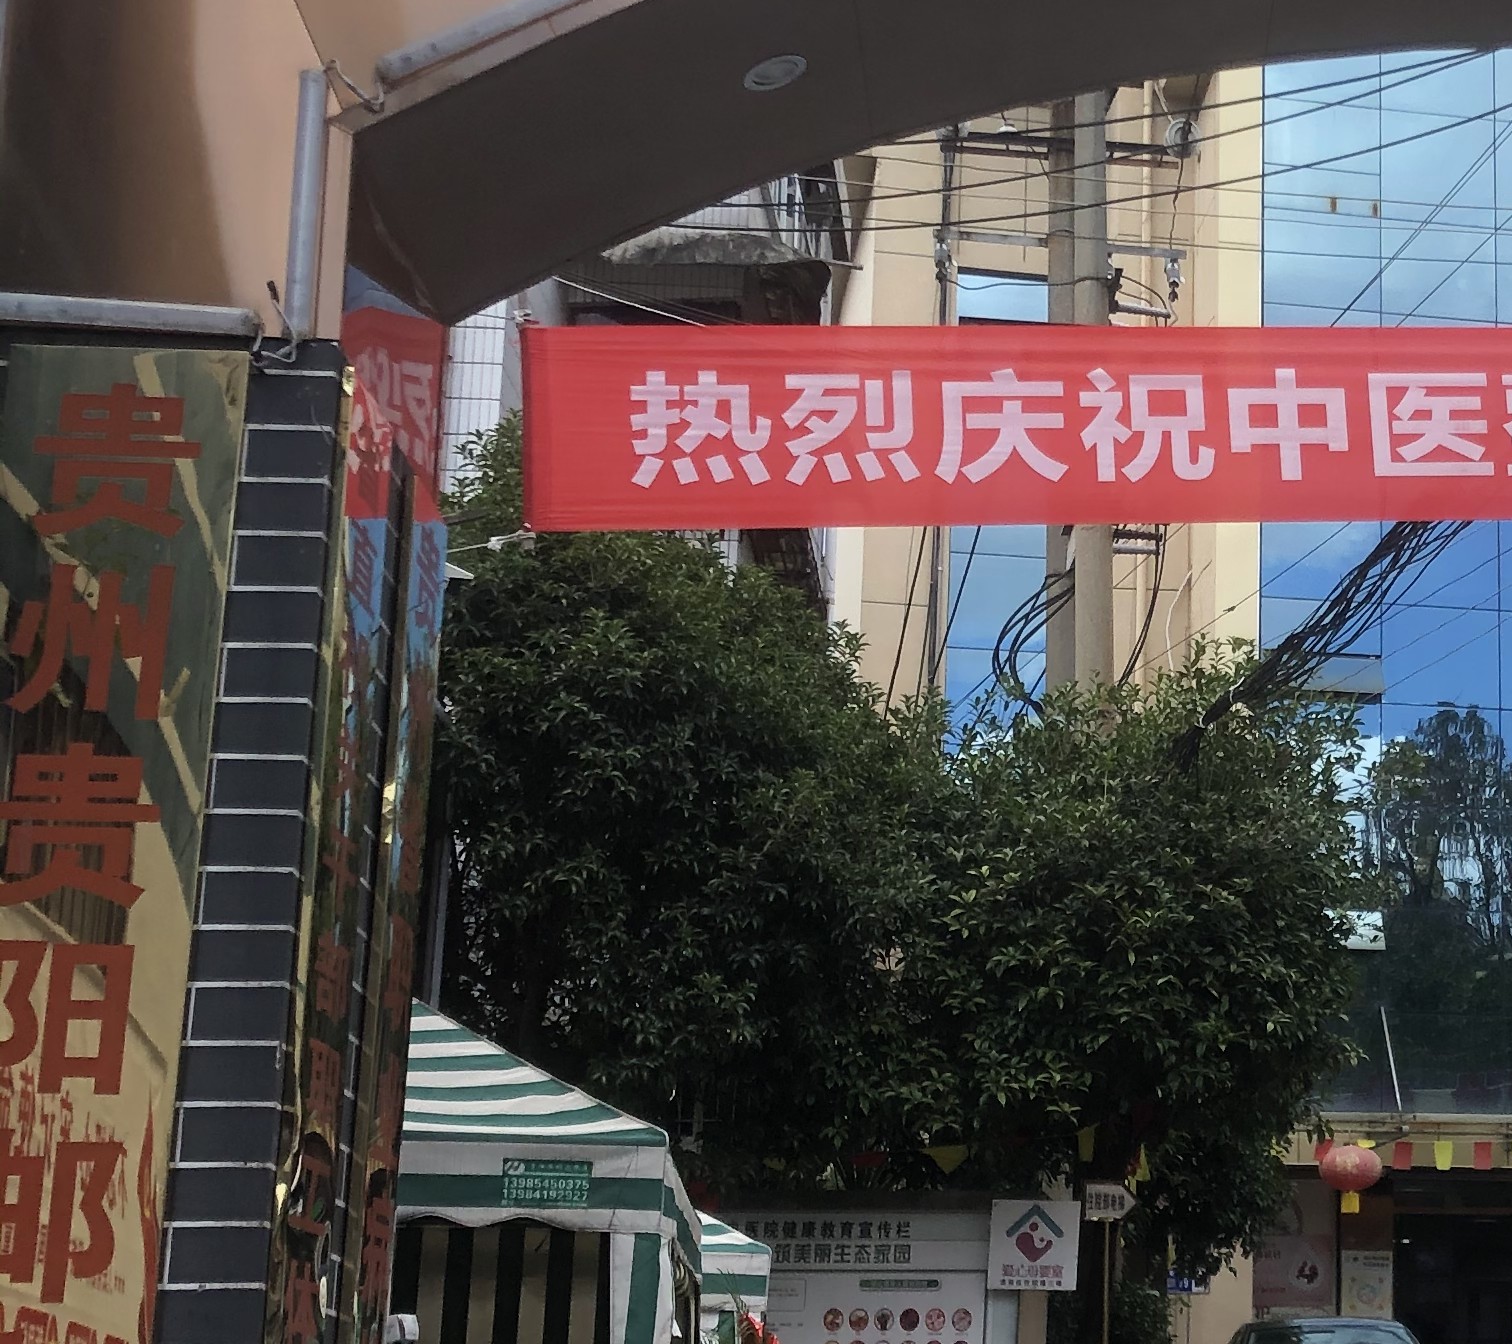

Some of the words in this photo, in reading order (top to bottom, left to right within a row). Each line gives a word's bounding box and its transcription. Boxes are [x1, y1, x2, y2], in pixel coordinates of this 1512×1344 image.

[736, 1220, 911, 1240] 医院健康教育宣传栏
